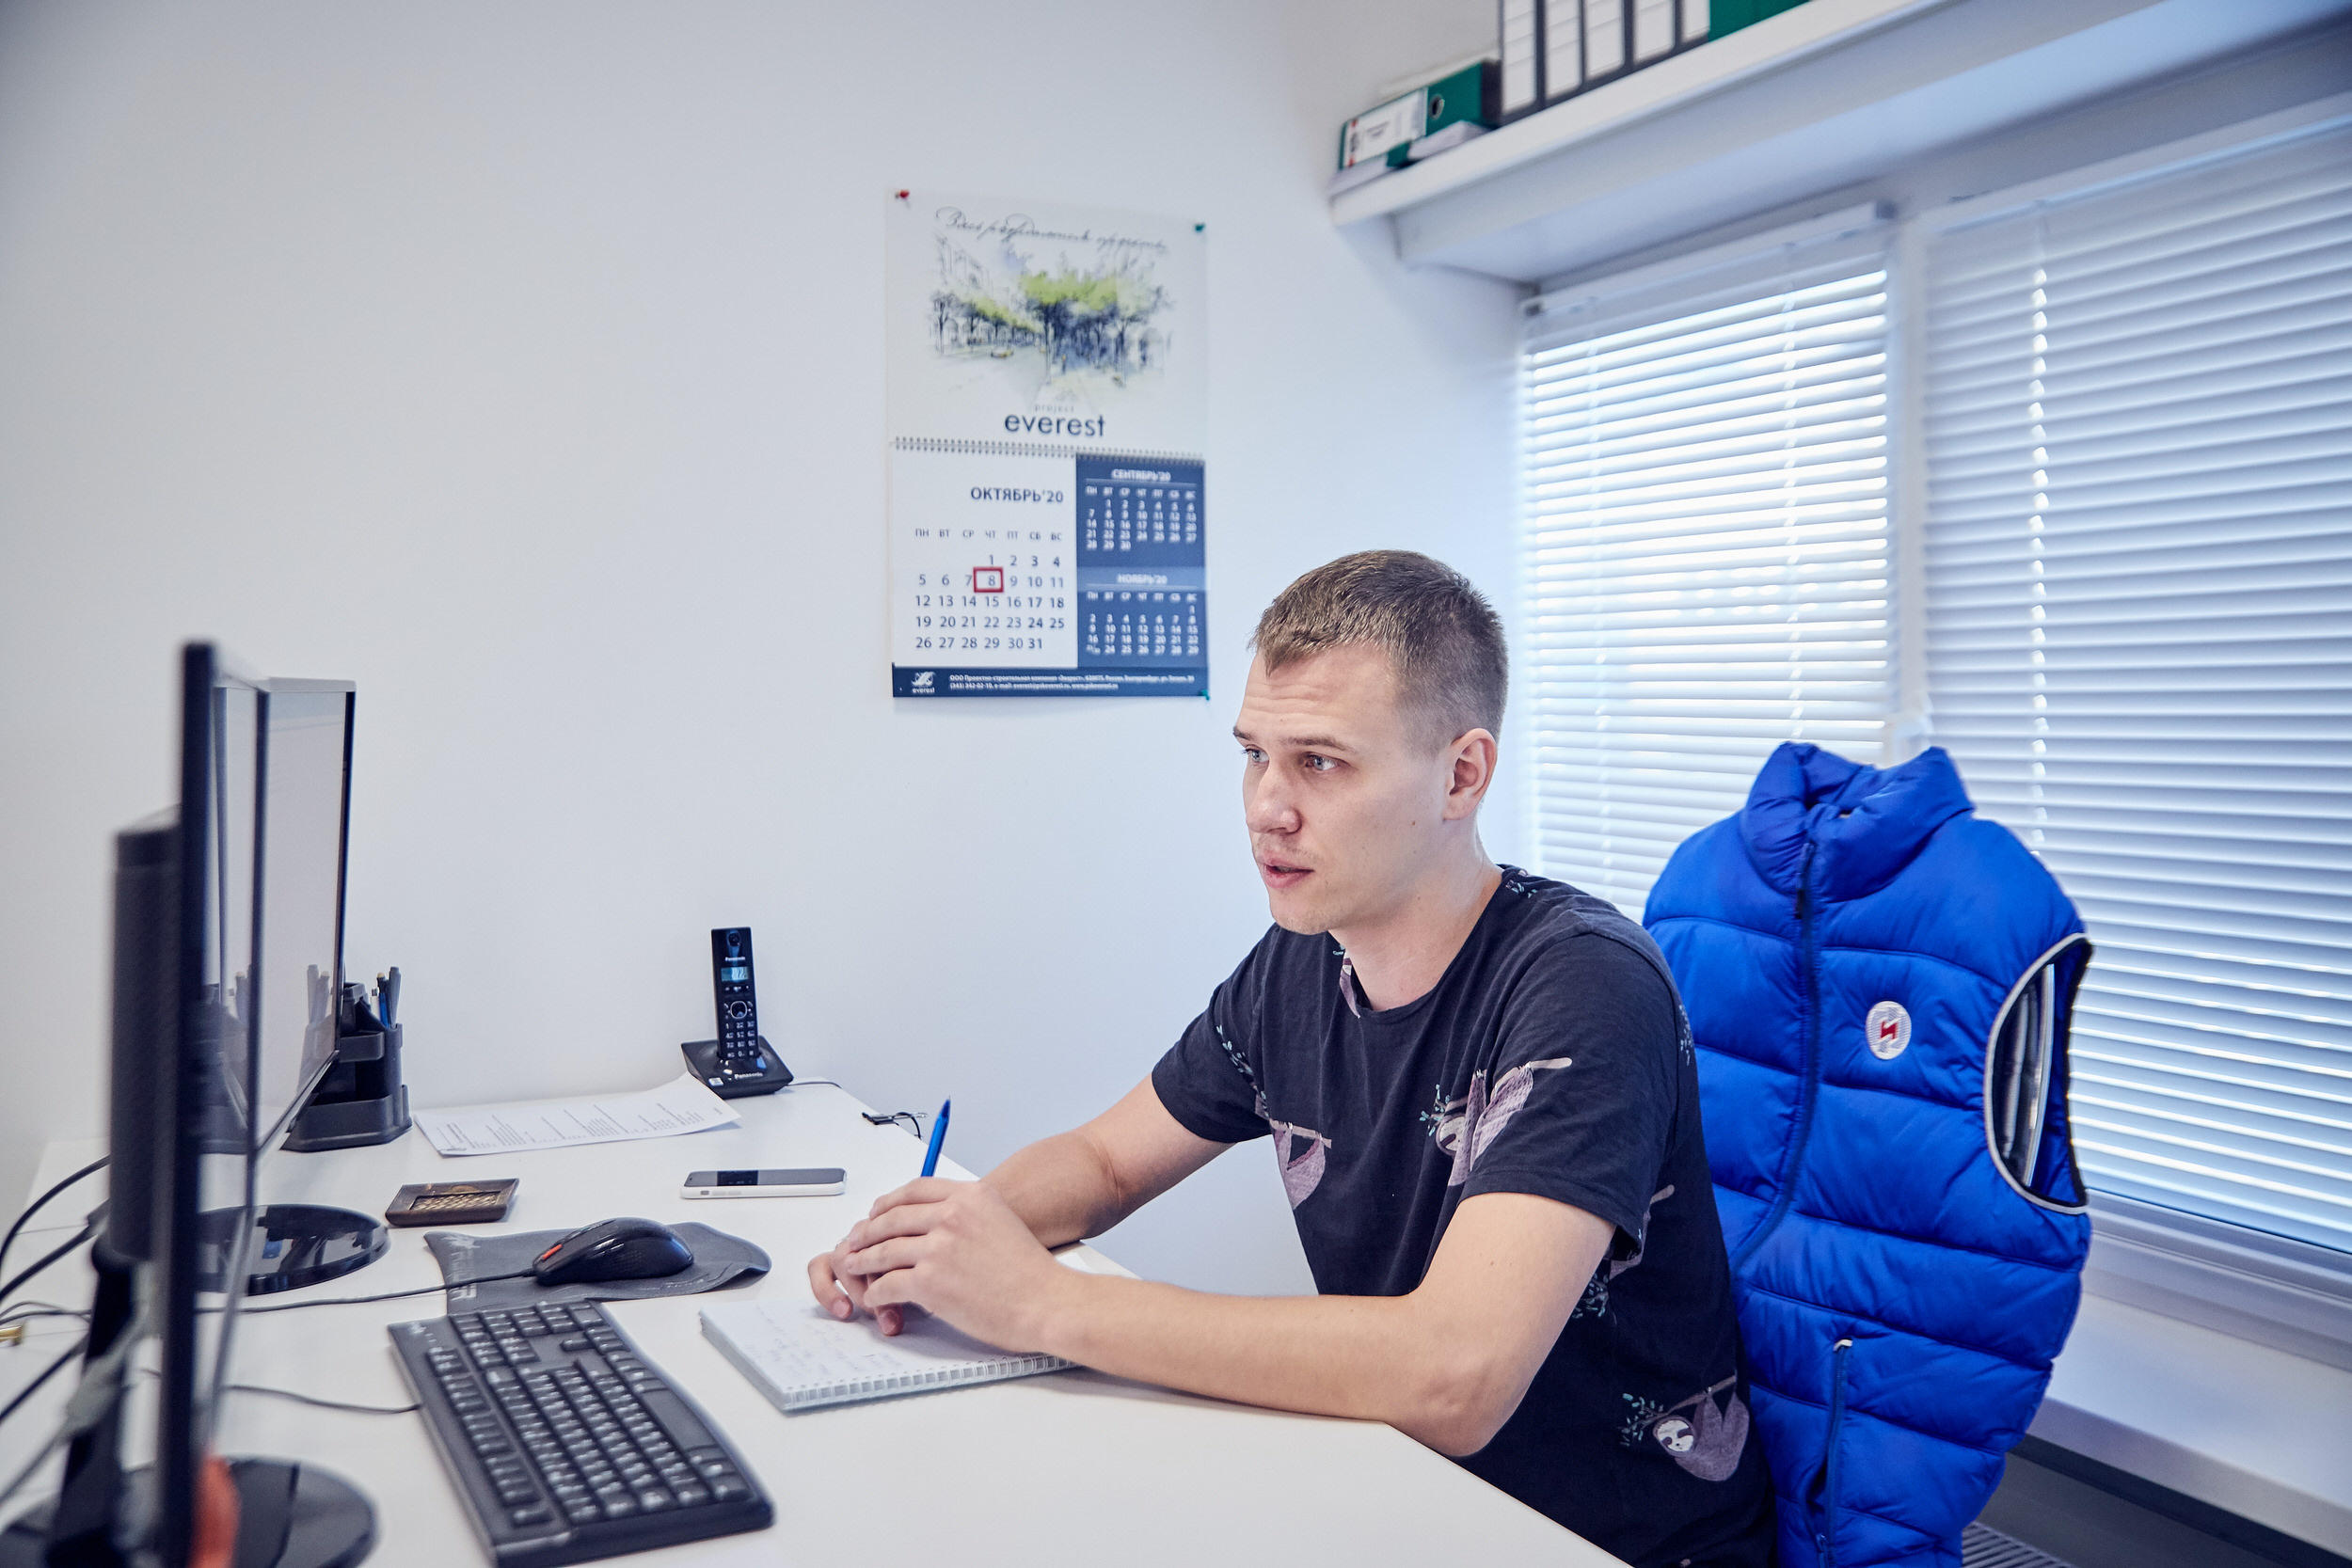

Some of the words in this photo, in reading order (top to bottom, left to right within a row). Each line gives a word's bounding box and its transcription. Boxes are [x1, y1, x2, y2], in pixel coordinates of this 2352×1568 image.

[1004, 414, 1106, 436] everest
[914, 529, 930, 537] ПН
[939, 529, 950, 538] ВТ
[962, 530, 975, 538] СР
[984, 531, 996, 539] ЧТ
[1008, 531, 1019, 539] ПТ
[1029, 531, 1041, 540] СБ
[1051, 531, 1062, 541] ВС
[989, 555, 994, 566] 1
[1010, 555, 1017, 566] 2
[1031, 556, 1039, 567] 3
[1053, 556, 1060, 567] 4
[918, 574, 927, 585] 5
[942, 575, 949, 585] 6
[965, 575, 973, 586] 7
[988, 575, 995, 586] 8
[1009, 576, 1018, 587] 9
[1027, 576, 1042, 587] 10
[1051, 577, 1064, 588] 11
[915, 595, 930, 607] 12
[939, 595, 954, 607] 13
[961, 595, 977, 607] 14
[984, 595, 999, 608] 15
[1007, 596, 1022, 608] 16
[1027, 596, 1041, 608] 17
[1050, 597, 1064, 609] 18
[915, 616, 931, 627] 19
[940, 617, 956, 627] 20
[961, 617, 976, 627] 21
[984, 617, 1000, 628] 22
[1007, 617, 1022, 628] 23
[1028, 617, 1043, 628] 24
[1050, 617, 1064, 629] 25
[915, 637, 931, 648] 26
[939, 637, 954, 648] 27
[961, 637, 977, 648] 28
[984, 637, 1000, 649] 29
[1008, 638, 1023, 649] 30
[1028, 638, 1042, 649] 31
